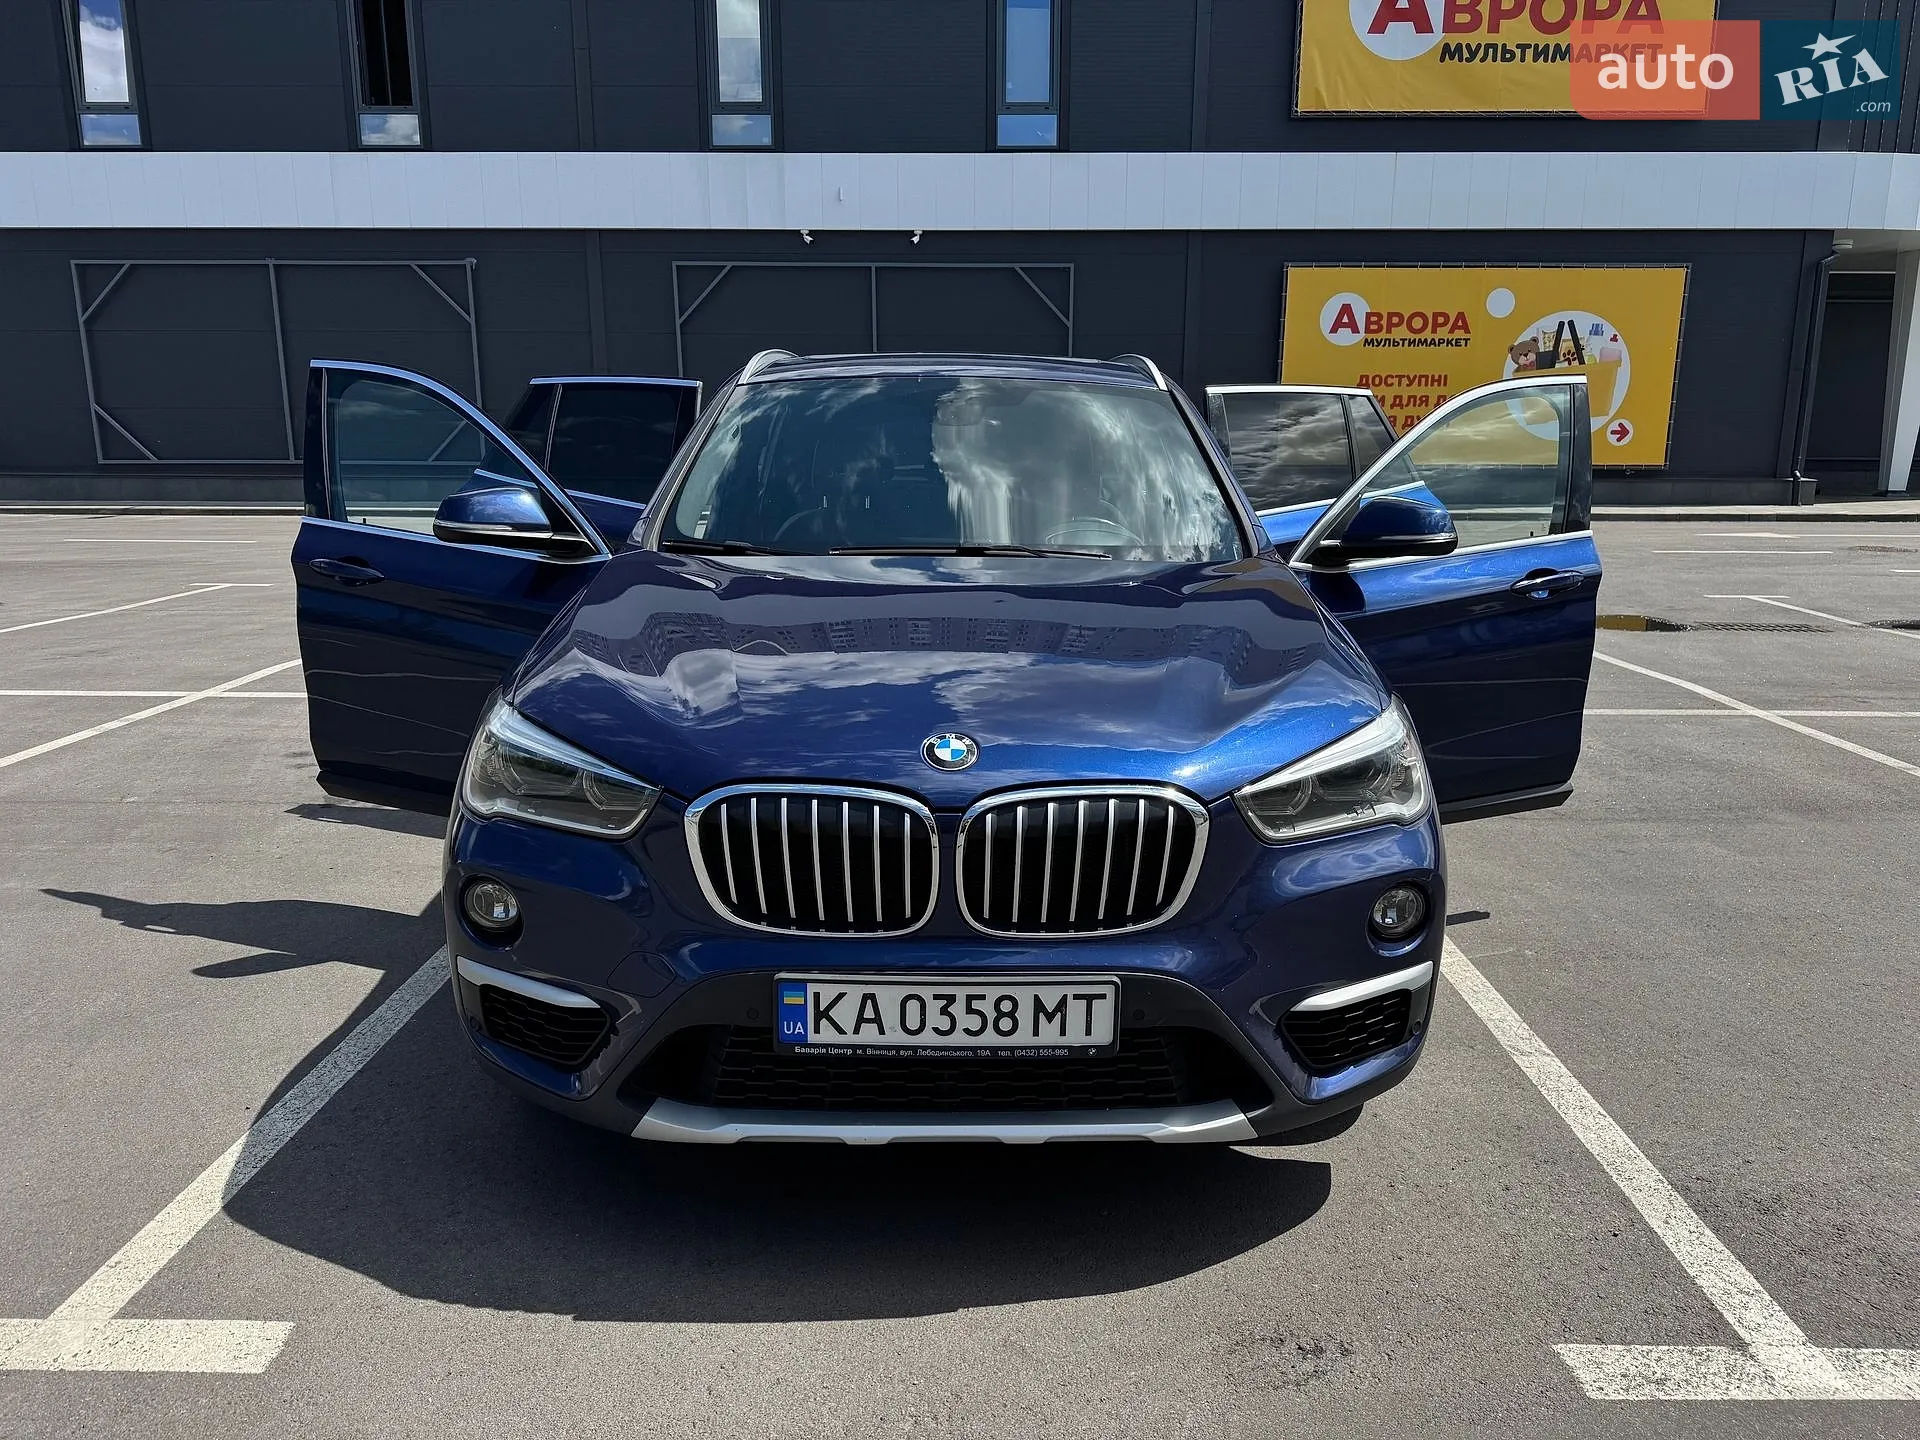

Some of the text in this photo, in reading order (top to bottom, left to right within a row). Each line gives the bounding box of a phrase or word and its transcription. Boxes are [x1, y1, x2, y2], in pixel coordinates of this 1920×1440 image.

[1329, 303, 1471, 334] АВРОРА
[1363, 337, 1471, 347] МУЛЬТИМАРКЕТ
[1357, 374, 1449, 388] ДОСТУПНІ
[1390, 394, 1430, 409] ДЛЯ
[899, 993, 1020, 1038] 0358
[783, 1021, 805, 1035] UA
[794, 1046, 826, 1055] Баварія
[828, 1047, 852, 1055] Центр
[1014, 1049, 1038, 1057] (0432)
